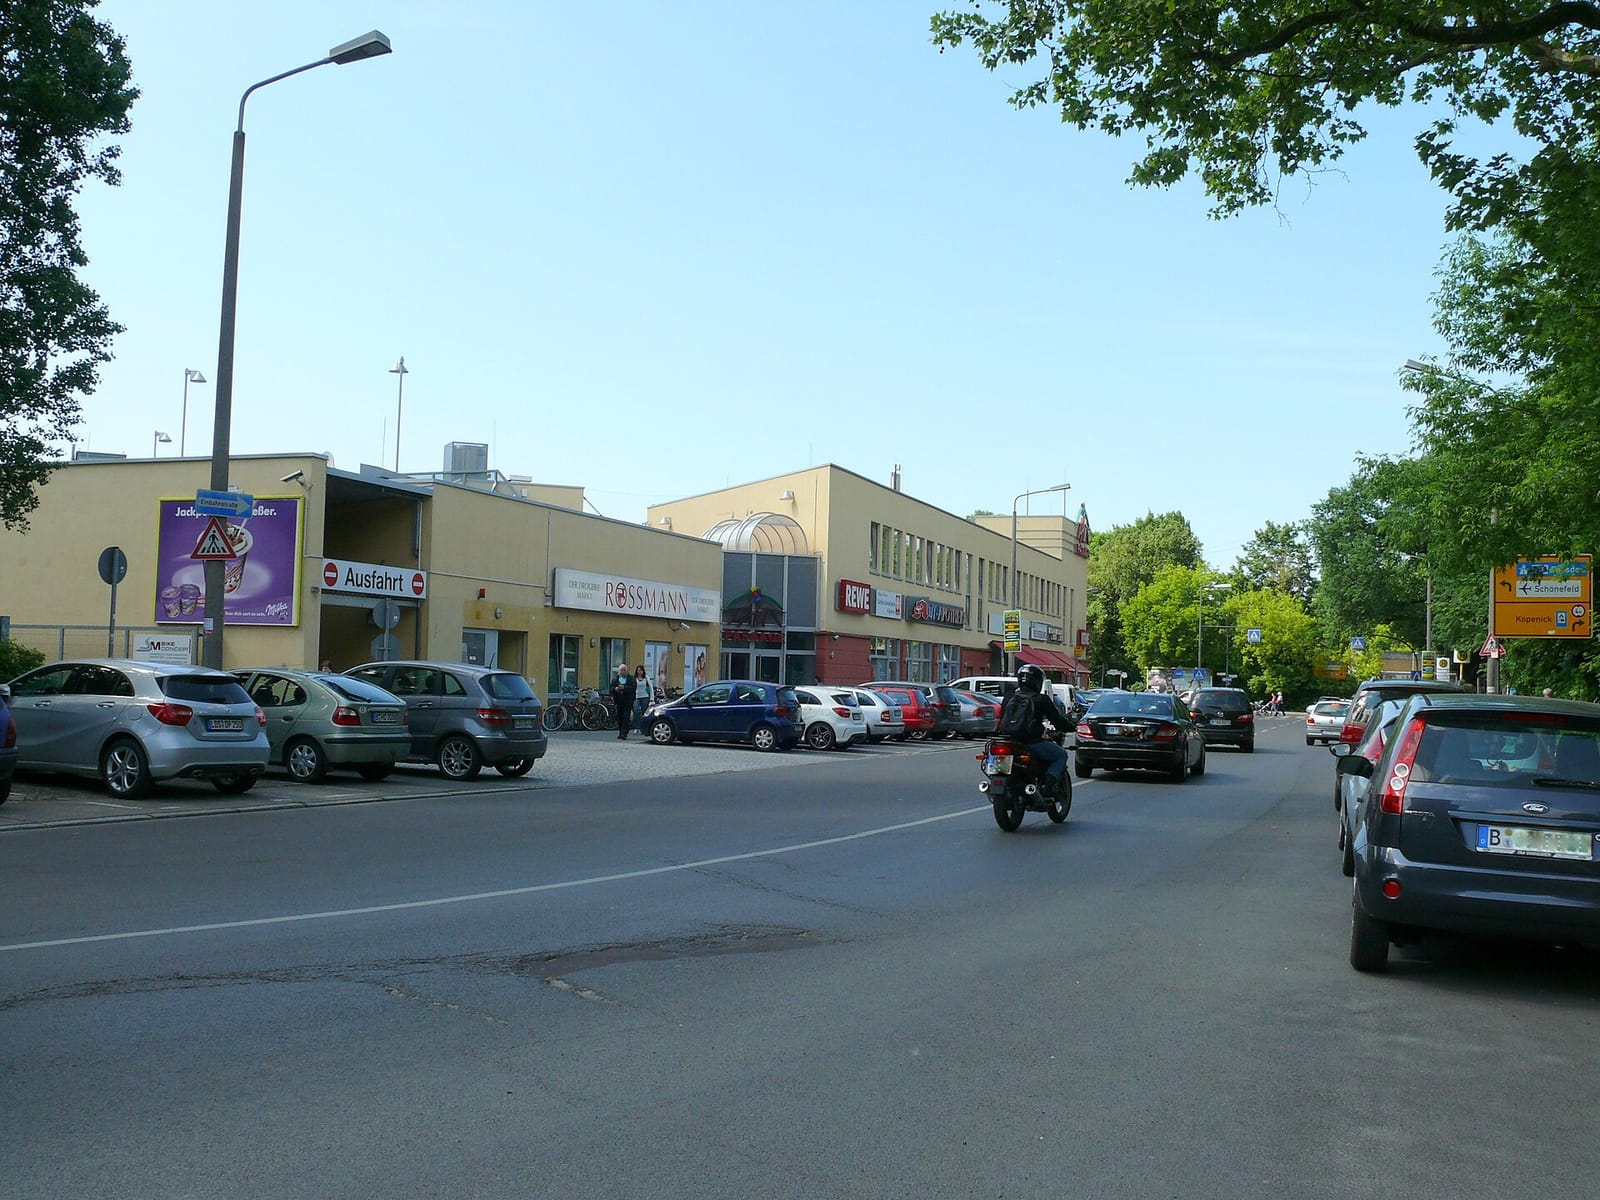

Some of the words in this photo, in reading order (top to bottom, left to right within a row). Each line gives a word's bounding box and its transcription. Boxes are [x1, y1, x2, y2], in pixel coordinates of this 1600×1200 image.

[175, 507, 208, 518] Jackp
[252, 505, 277, 516] eßer.
[344, 567, 404, 591] Ausfahrt
[605, 582, 688, 614] ROSSMANN
[845, 584, 870, 610] REWE
[265, 602, 289, 615] Milka
[1489, 829, 1501, 846] B
